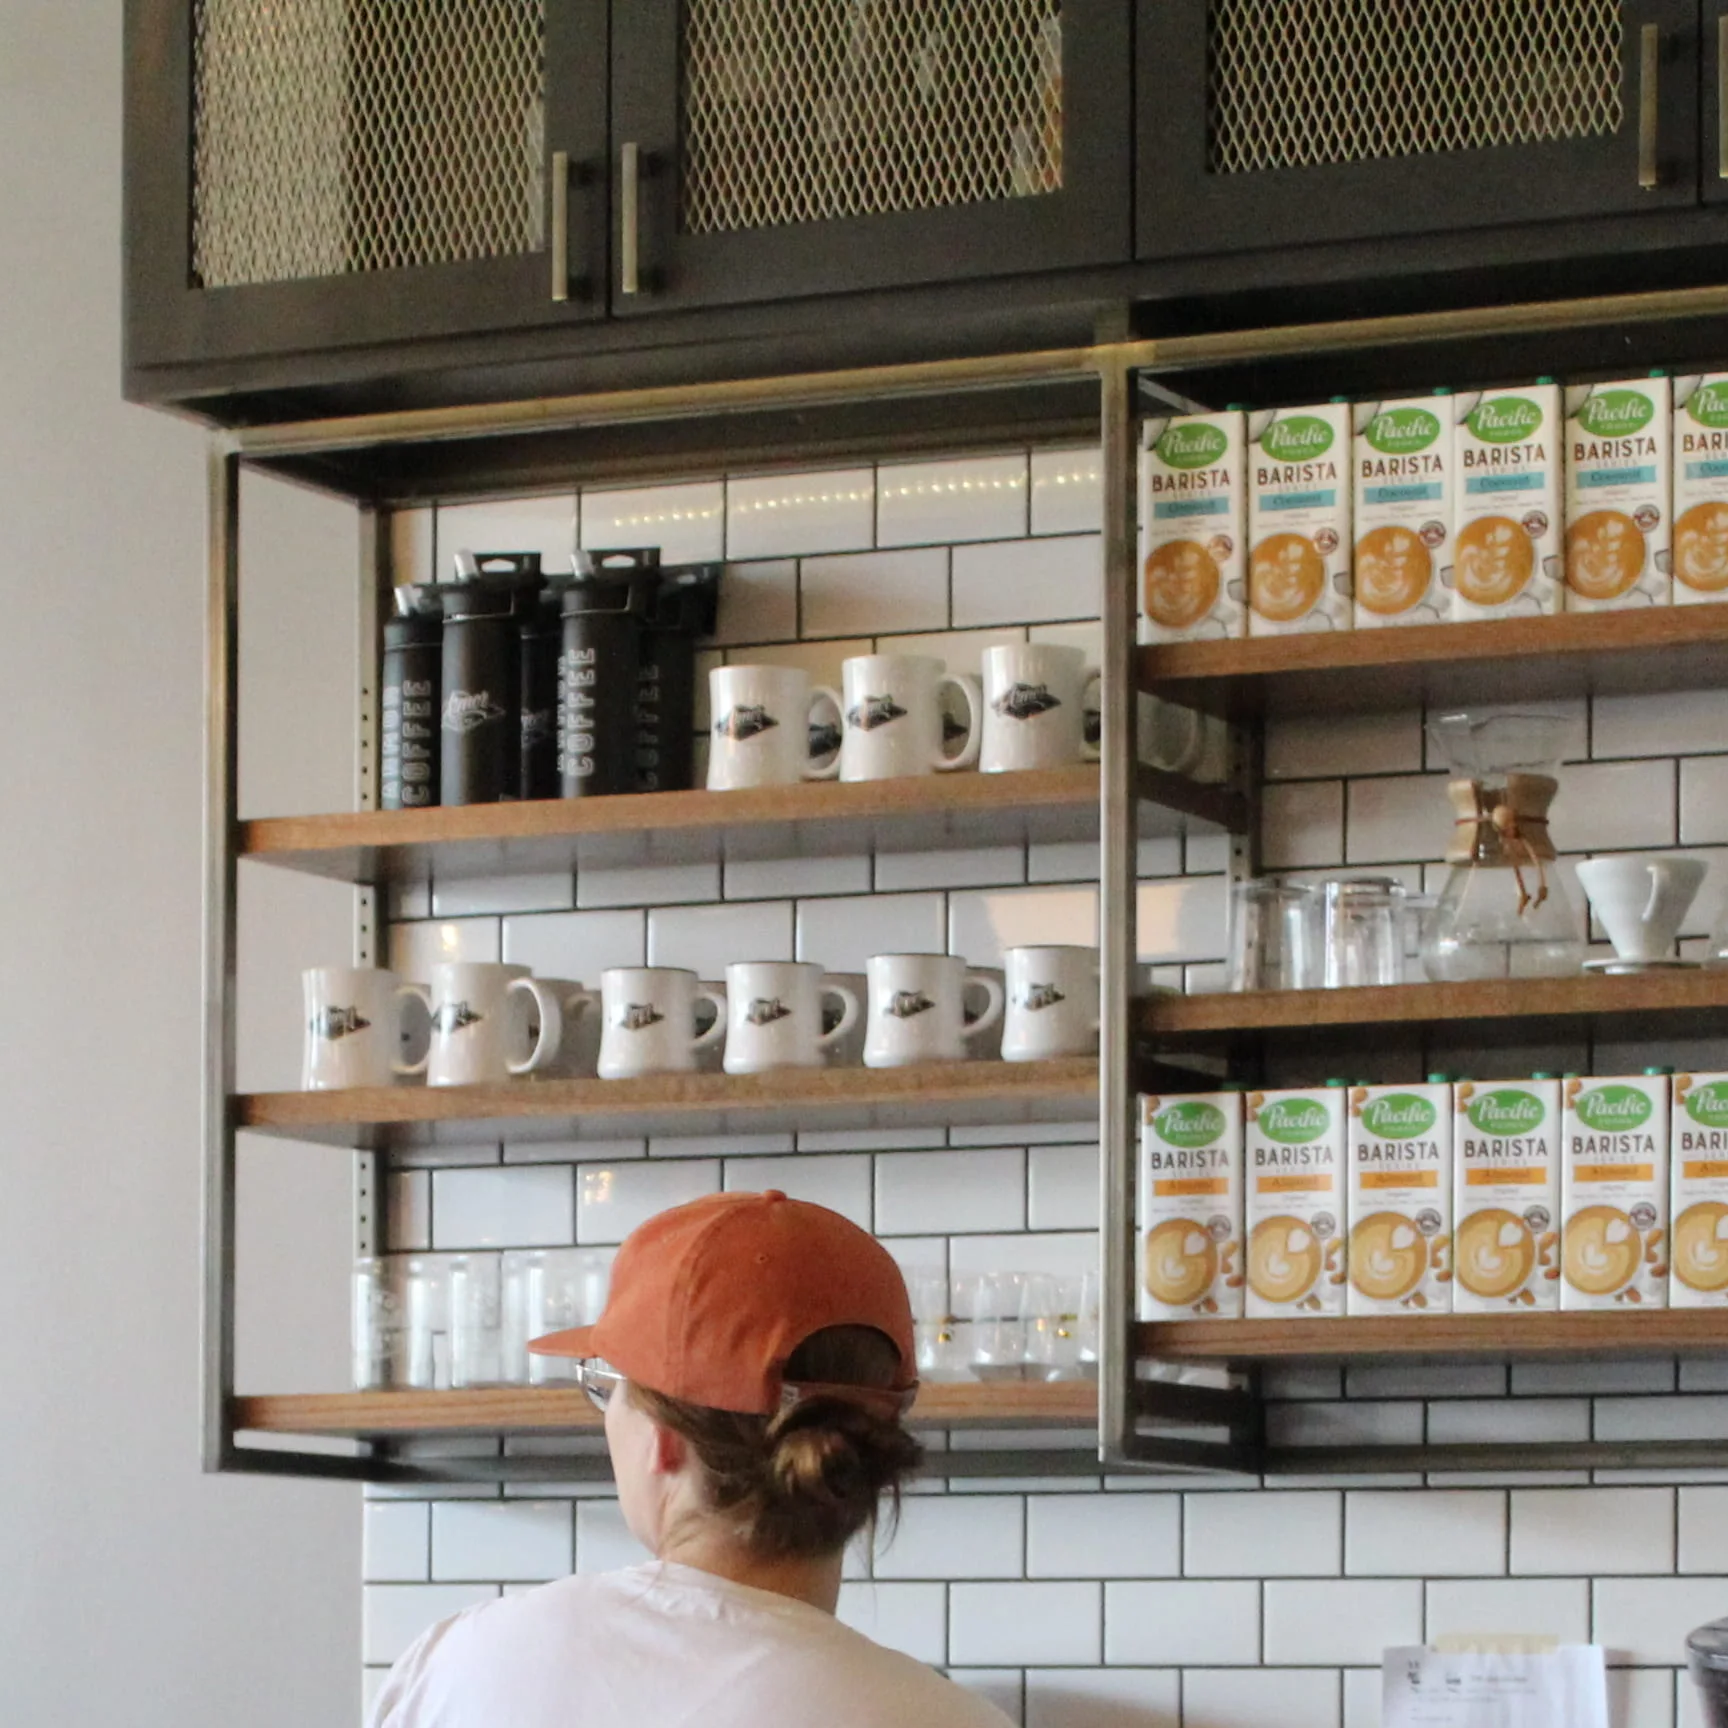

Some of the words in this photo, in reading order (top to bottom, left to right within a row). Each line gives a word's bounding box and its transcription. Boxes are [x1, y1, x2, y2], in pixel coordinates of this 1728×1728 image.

[1474, 403, 1537, 432] Pacific
[1584, 397, 1647, 425] Pacific
[1268, 422, 1328, 450] Pacific
[1373, 414, 1434, 441] Pacific
[1162, 429, 1221, 458] Pacific
[1463, 443, 1546, 468] BARISTA
[1573, 436, 1657, 462] BARISTA
[1256, 461, 1337, 486] BARISTA
[1361, 453, 1444, 478] BARISTA
[1151, 468, 1231, 493] BARISTA
[567, 648, 596, 777] COFFEE
[402, 680, 431, 805] COFFEE
[1254, 1144, 1334, 1166] BARISTA
[1358, 1141, 1440, 1162] BARISTA
[1464, 1138, 1548, 1158] BARISTA
[1572, 1134, 1656, 1155] BARISTA
[1151, 1149, 1230, 1170] BARISTA
